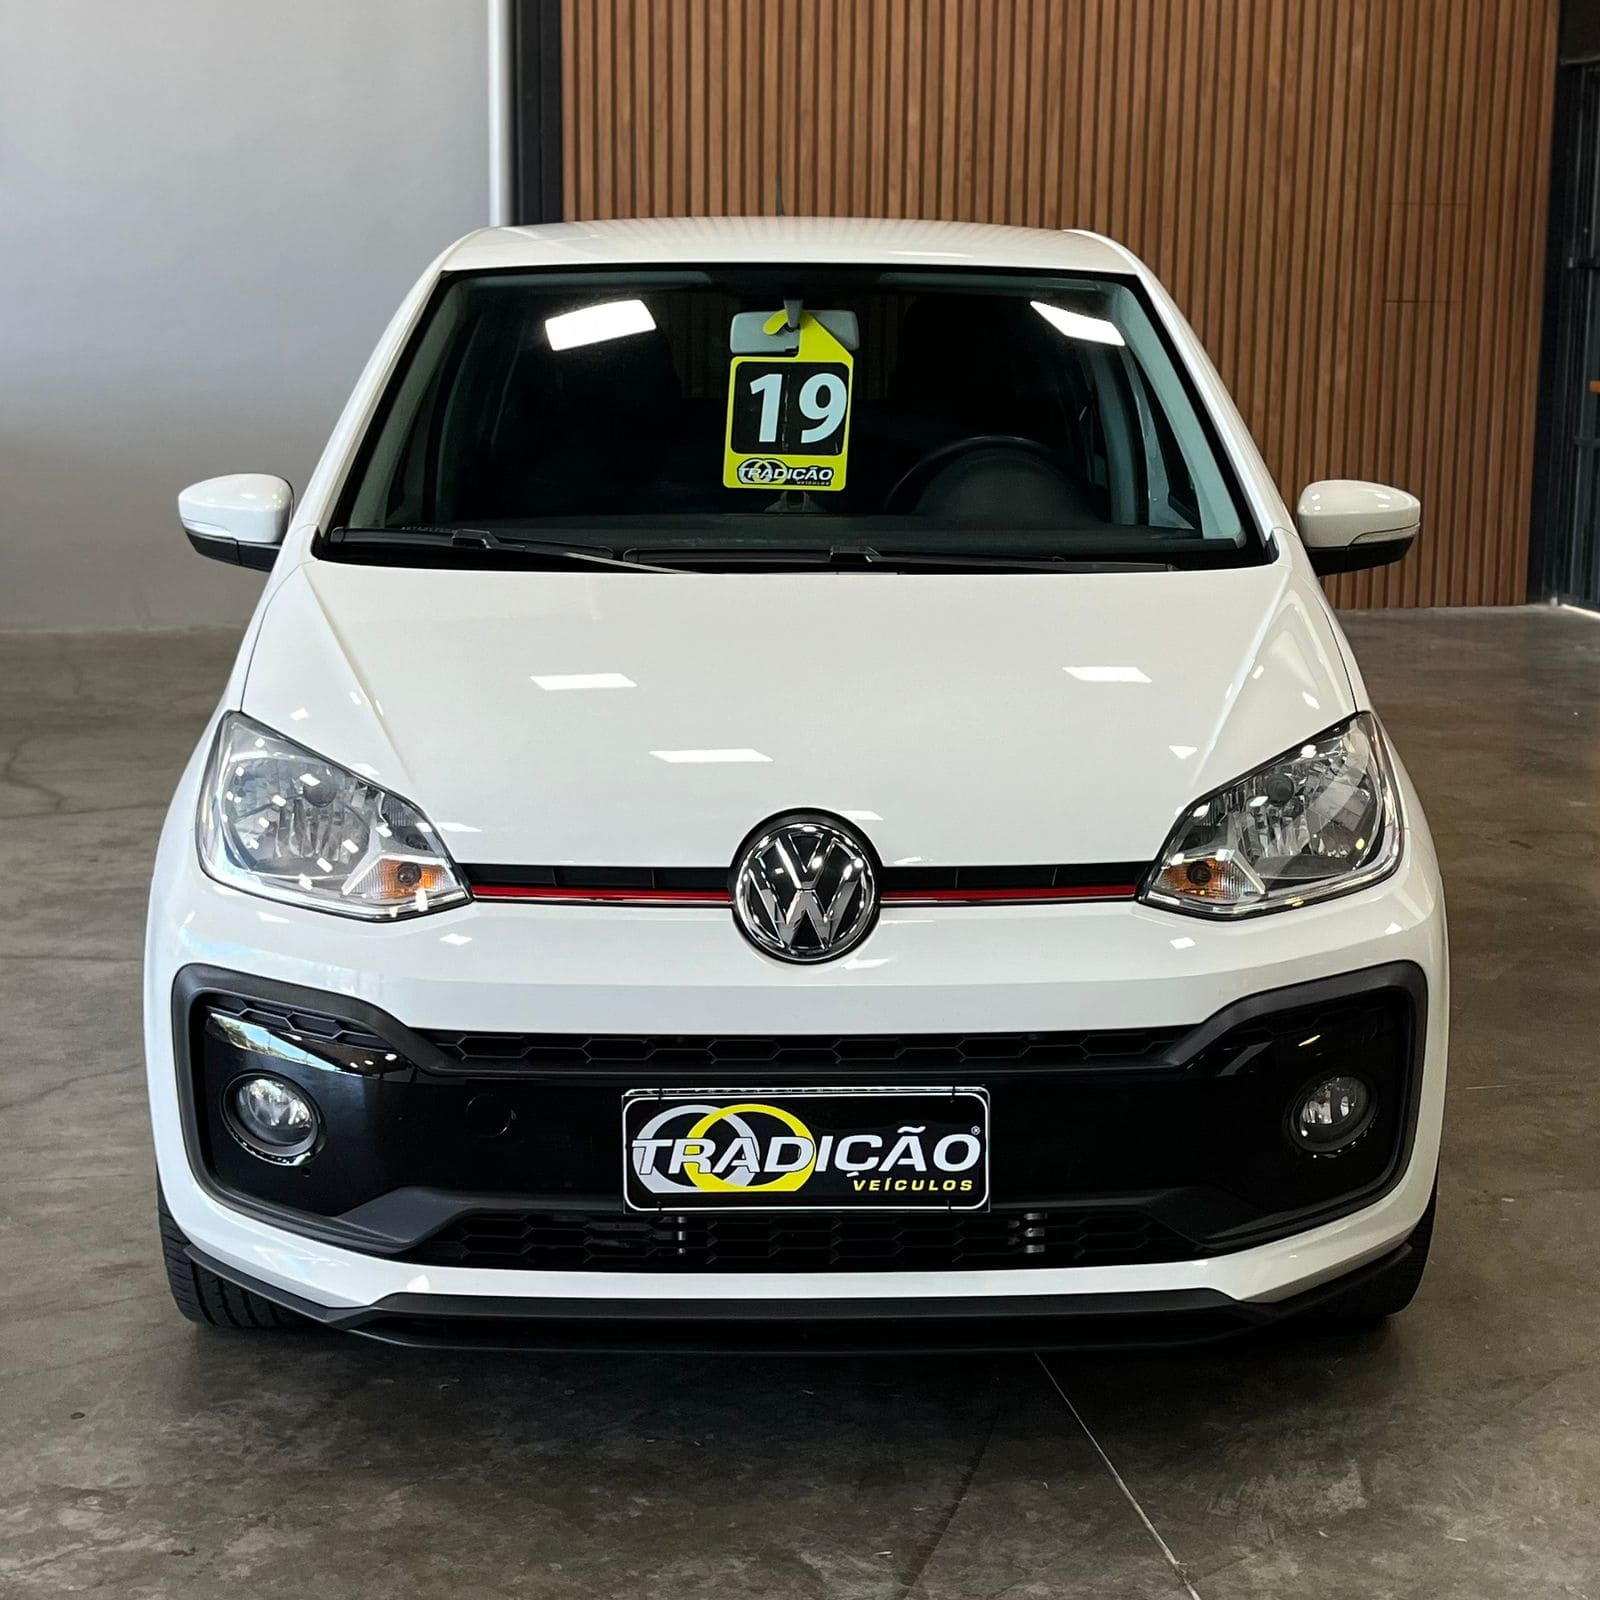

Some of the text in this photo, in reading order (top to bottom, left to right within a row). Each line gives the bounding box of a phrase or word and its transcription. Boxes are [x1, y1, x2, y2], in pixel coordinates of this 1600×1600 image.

[750, 373, 848, 443] 19
[739, 466, 833, 481] TRADIÇÃO
[744, 828, 867, 955] VW
[632, 1126, 981, 1177] TRADIÇÃO
[853, 1177, 974, 1192] VEÍCULOS
